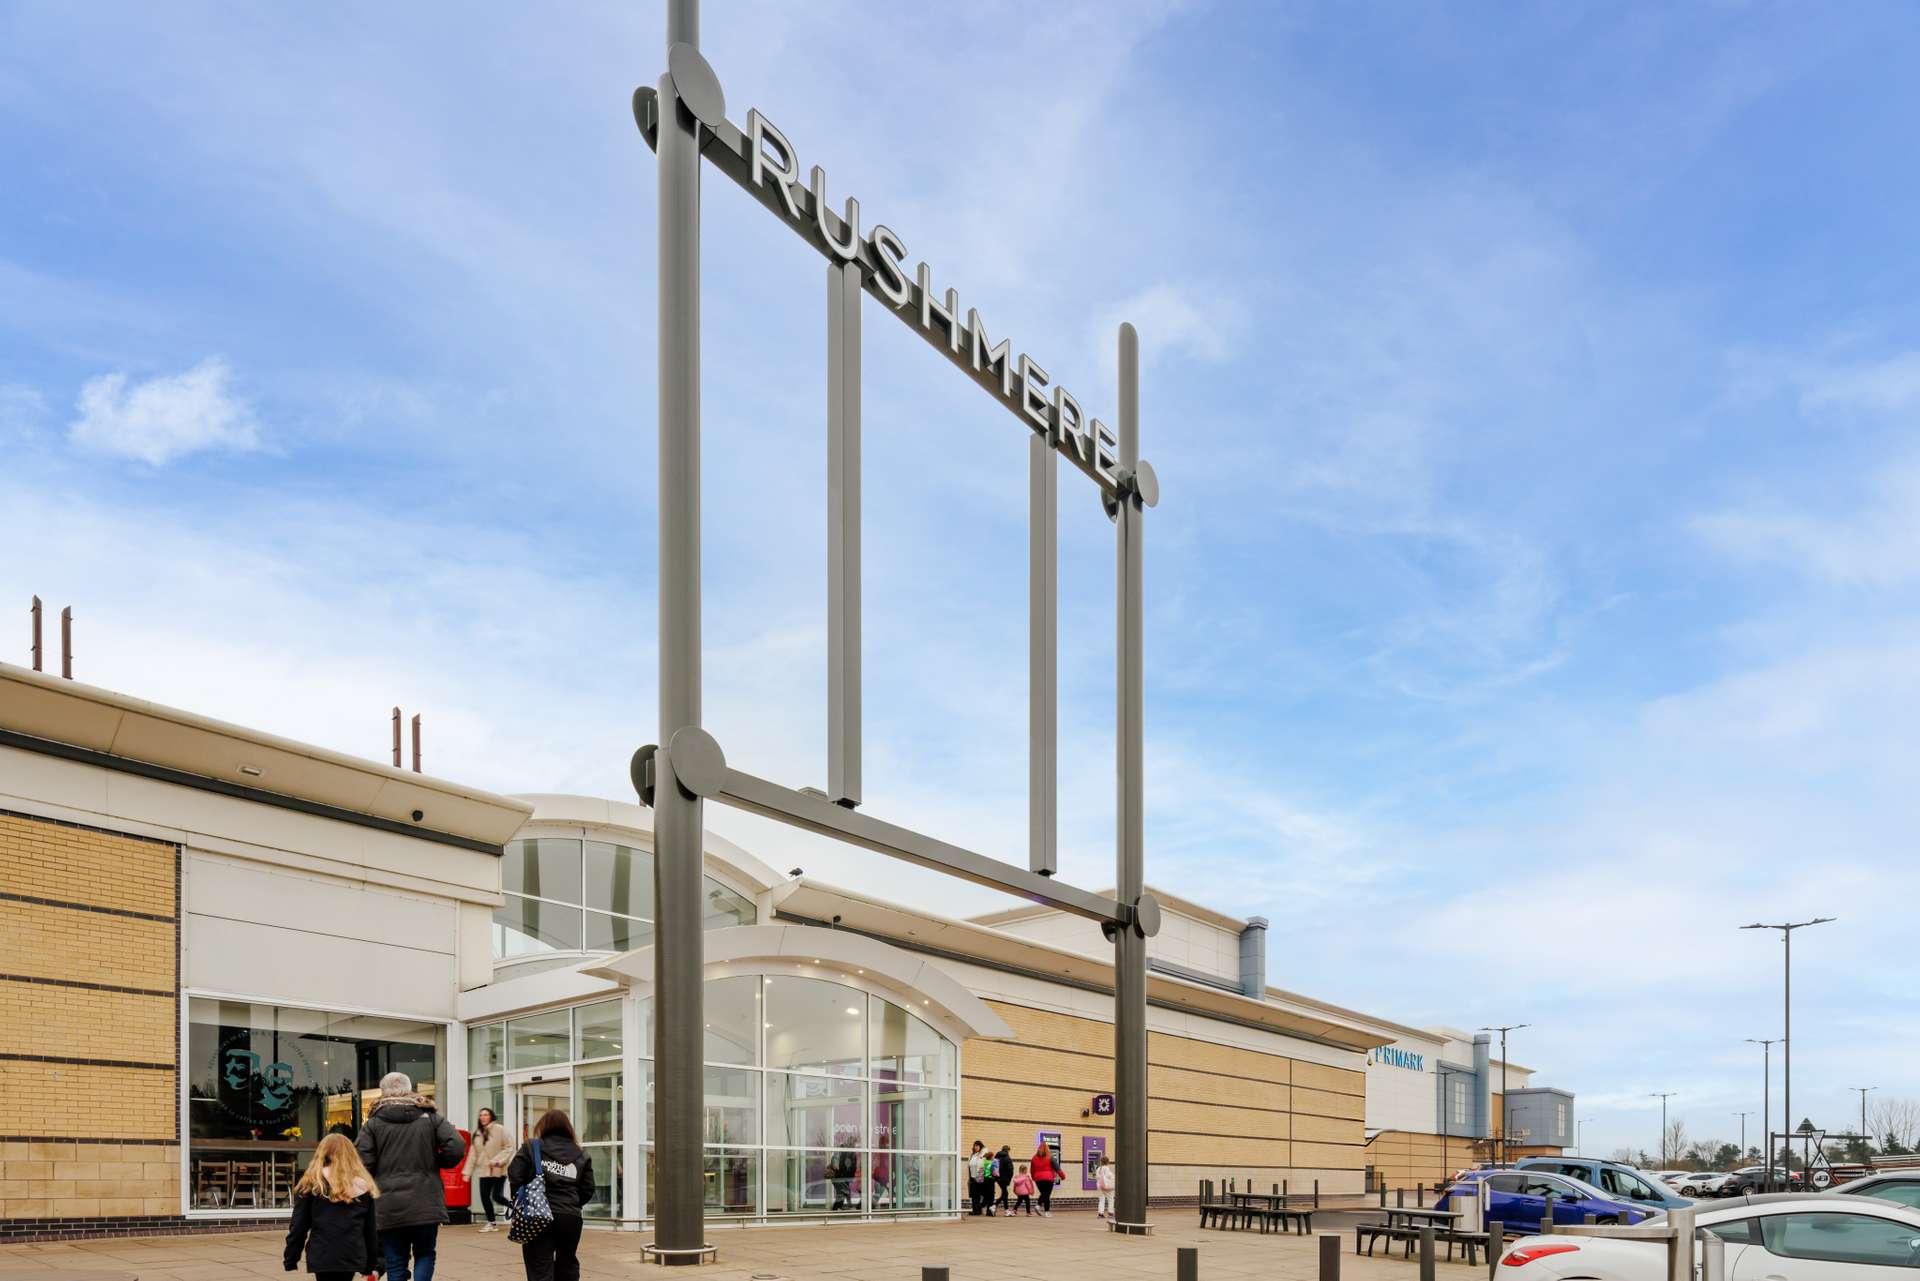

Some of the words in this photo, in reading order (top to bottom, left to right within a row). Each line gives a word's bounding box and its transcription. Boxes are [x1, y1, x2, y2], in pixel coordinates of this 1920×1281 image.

[747, 107, 1119, 487] RUSHMERE
[1375, 1045, 1424, 1072] PRIMARK
[541, 1160, 567, 1171] NORTH
[547, 1165, 568, 1177] FACE
